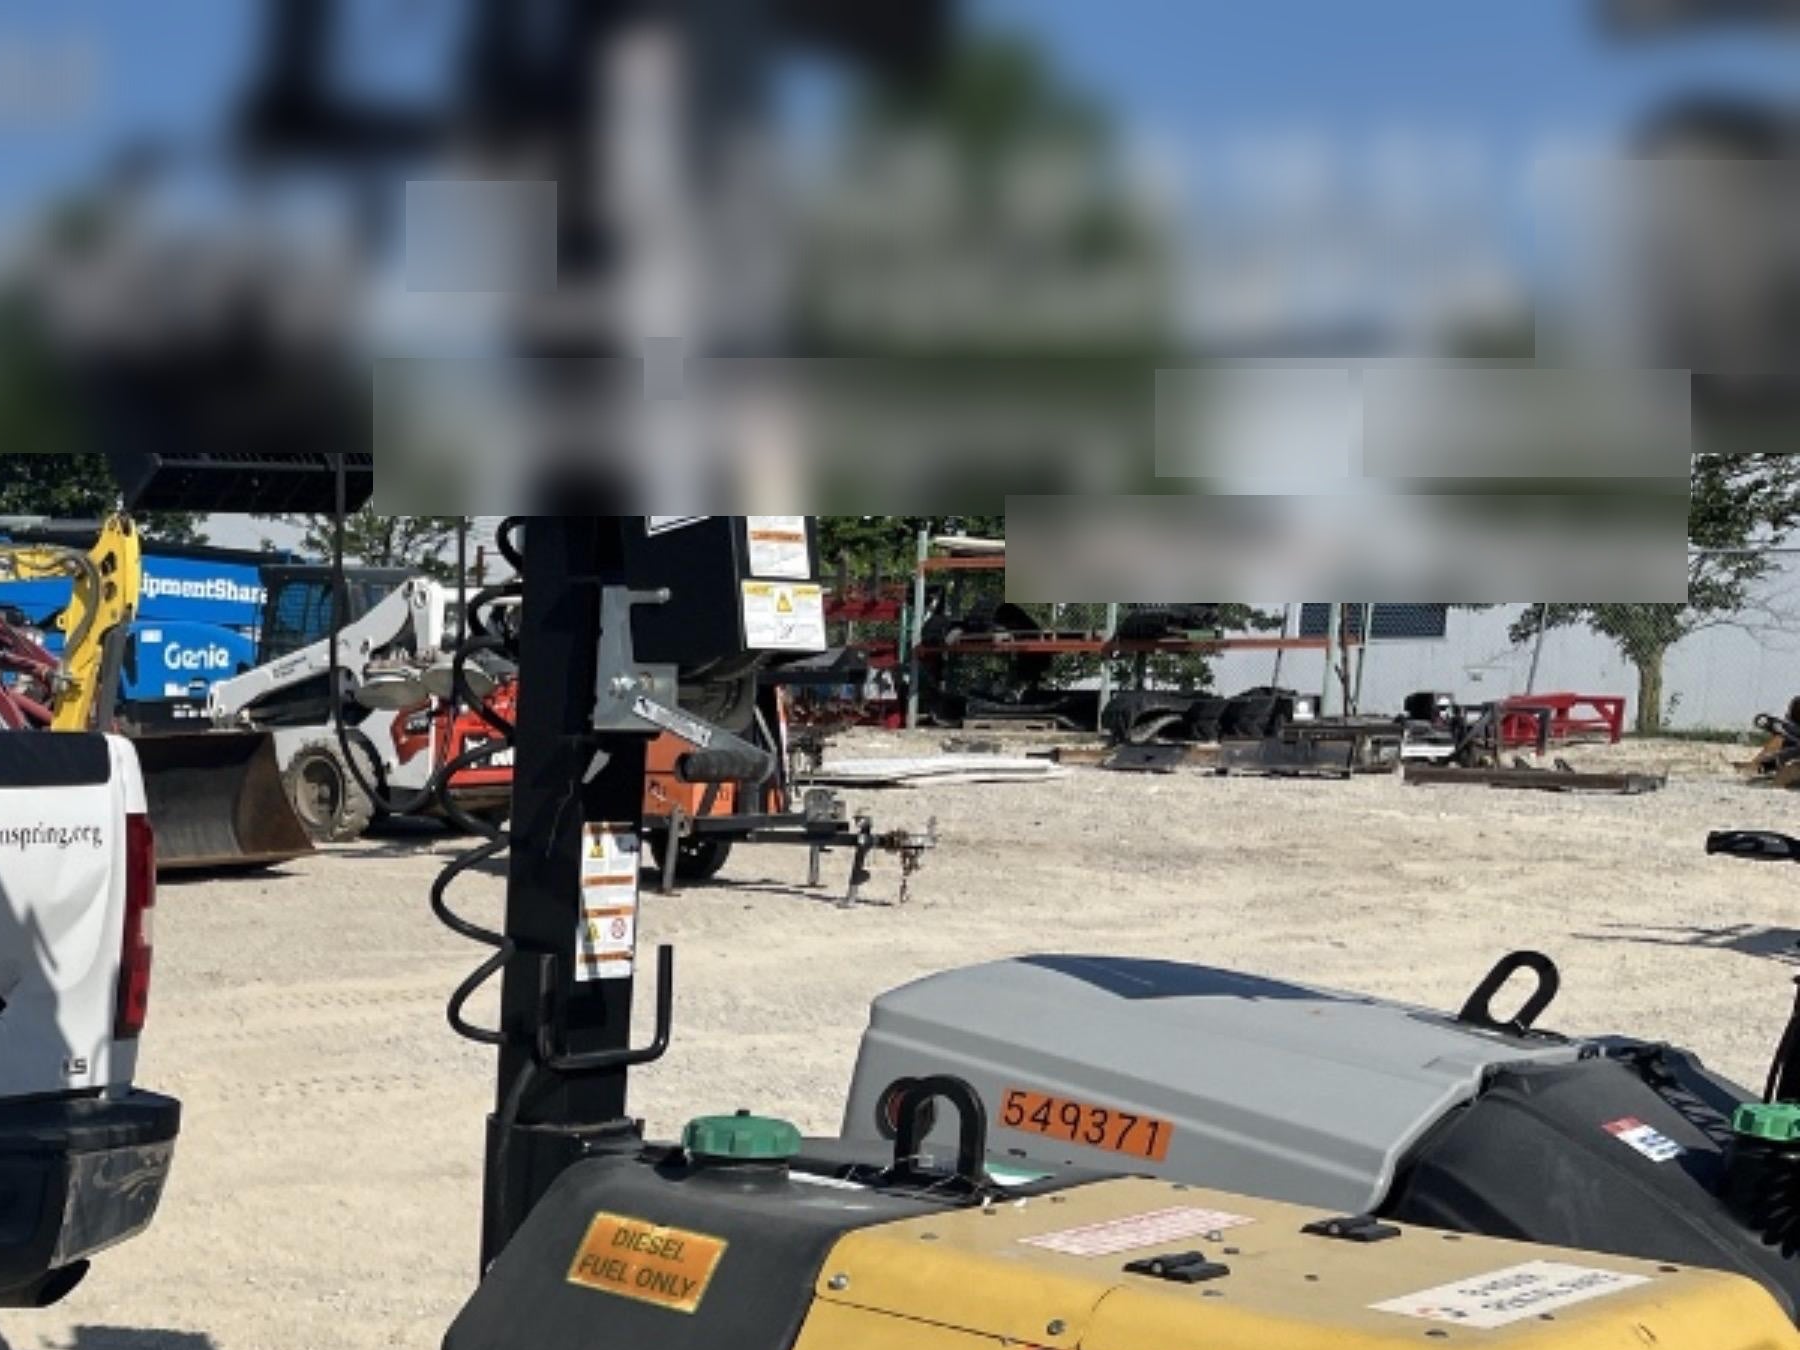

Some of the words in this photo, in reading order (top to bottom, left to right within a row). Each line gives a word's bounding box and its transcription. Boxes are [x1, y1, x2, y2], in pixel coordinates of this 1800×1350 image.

[164, 642, 230, 670] Genie
[1004, 1091, 1160, 1157] 549371
[611, 1227, 686, 1263] DIESEL
[578, 1253, 628, 1284] FUEL
[636, 1268, 697, 1299] ONLY
